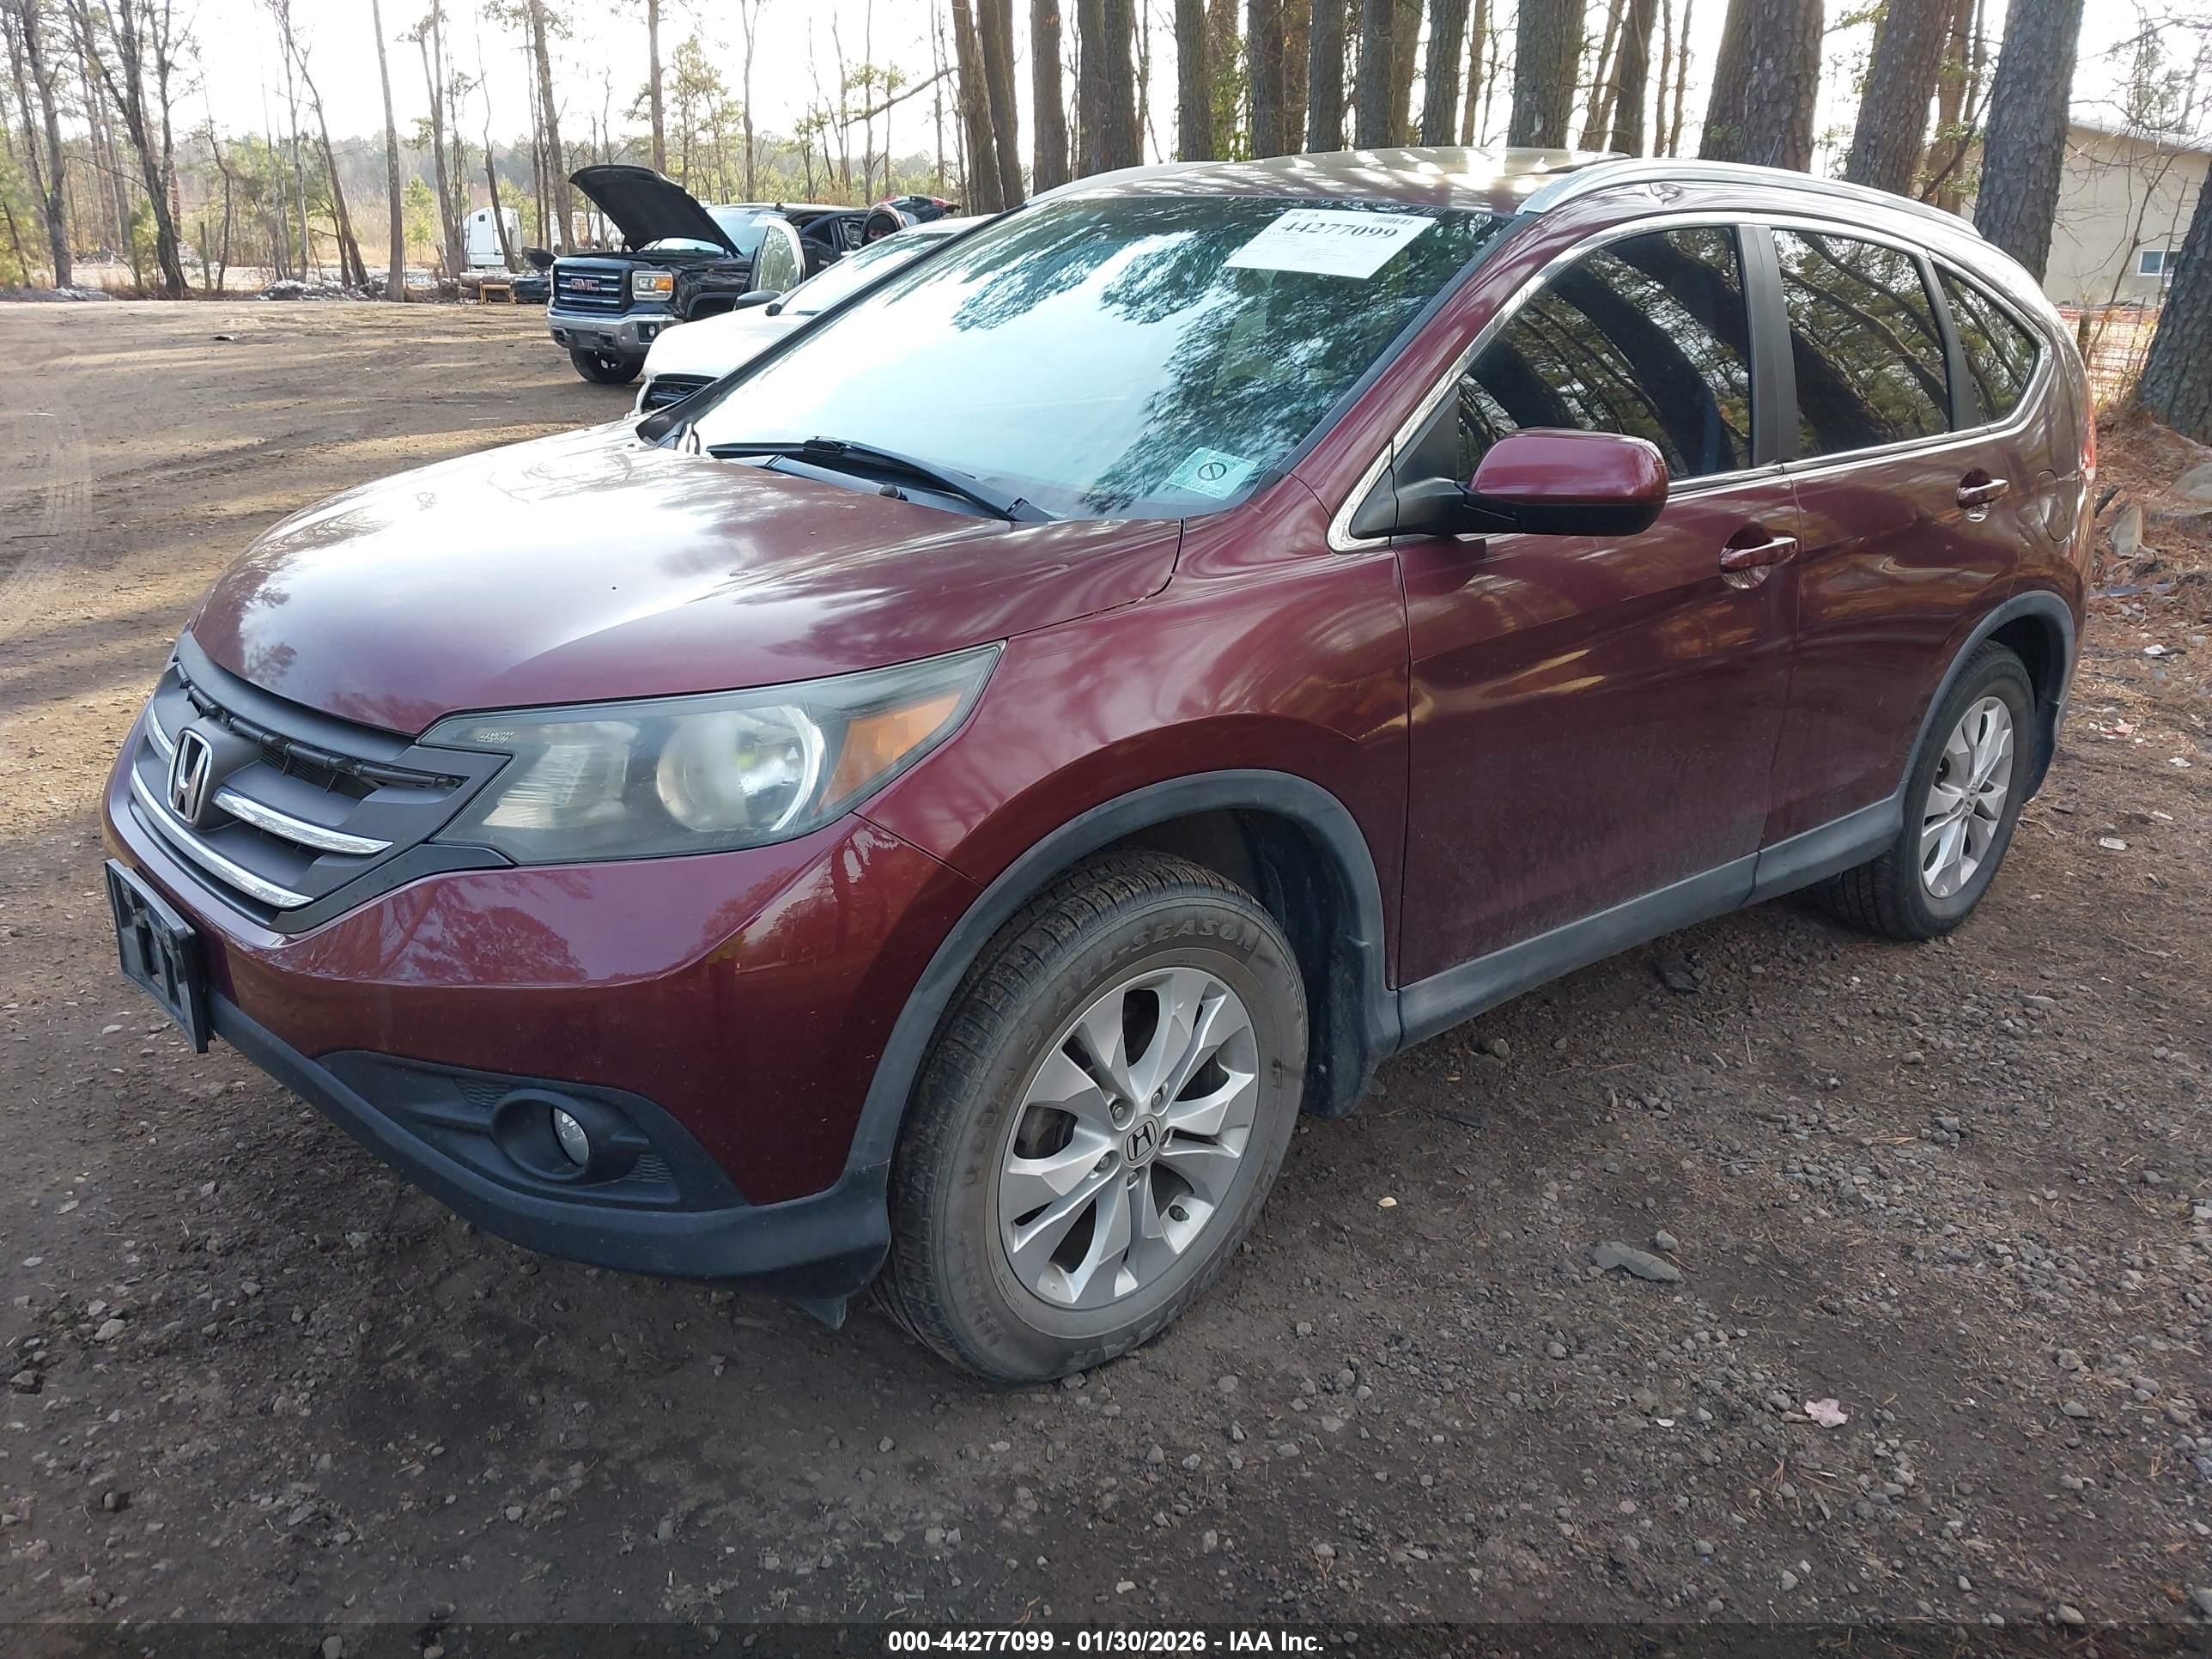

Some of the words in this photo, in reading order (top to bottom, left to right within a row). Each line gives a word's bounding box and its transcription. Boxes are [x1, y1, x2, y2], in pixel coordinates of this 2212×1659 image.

[1281, 221, 1398, 240] 44277099
[570, 278, 599, 291] GMC
[1054, 919, 1259, 1018] ALL-SEASON
